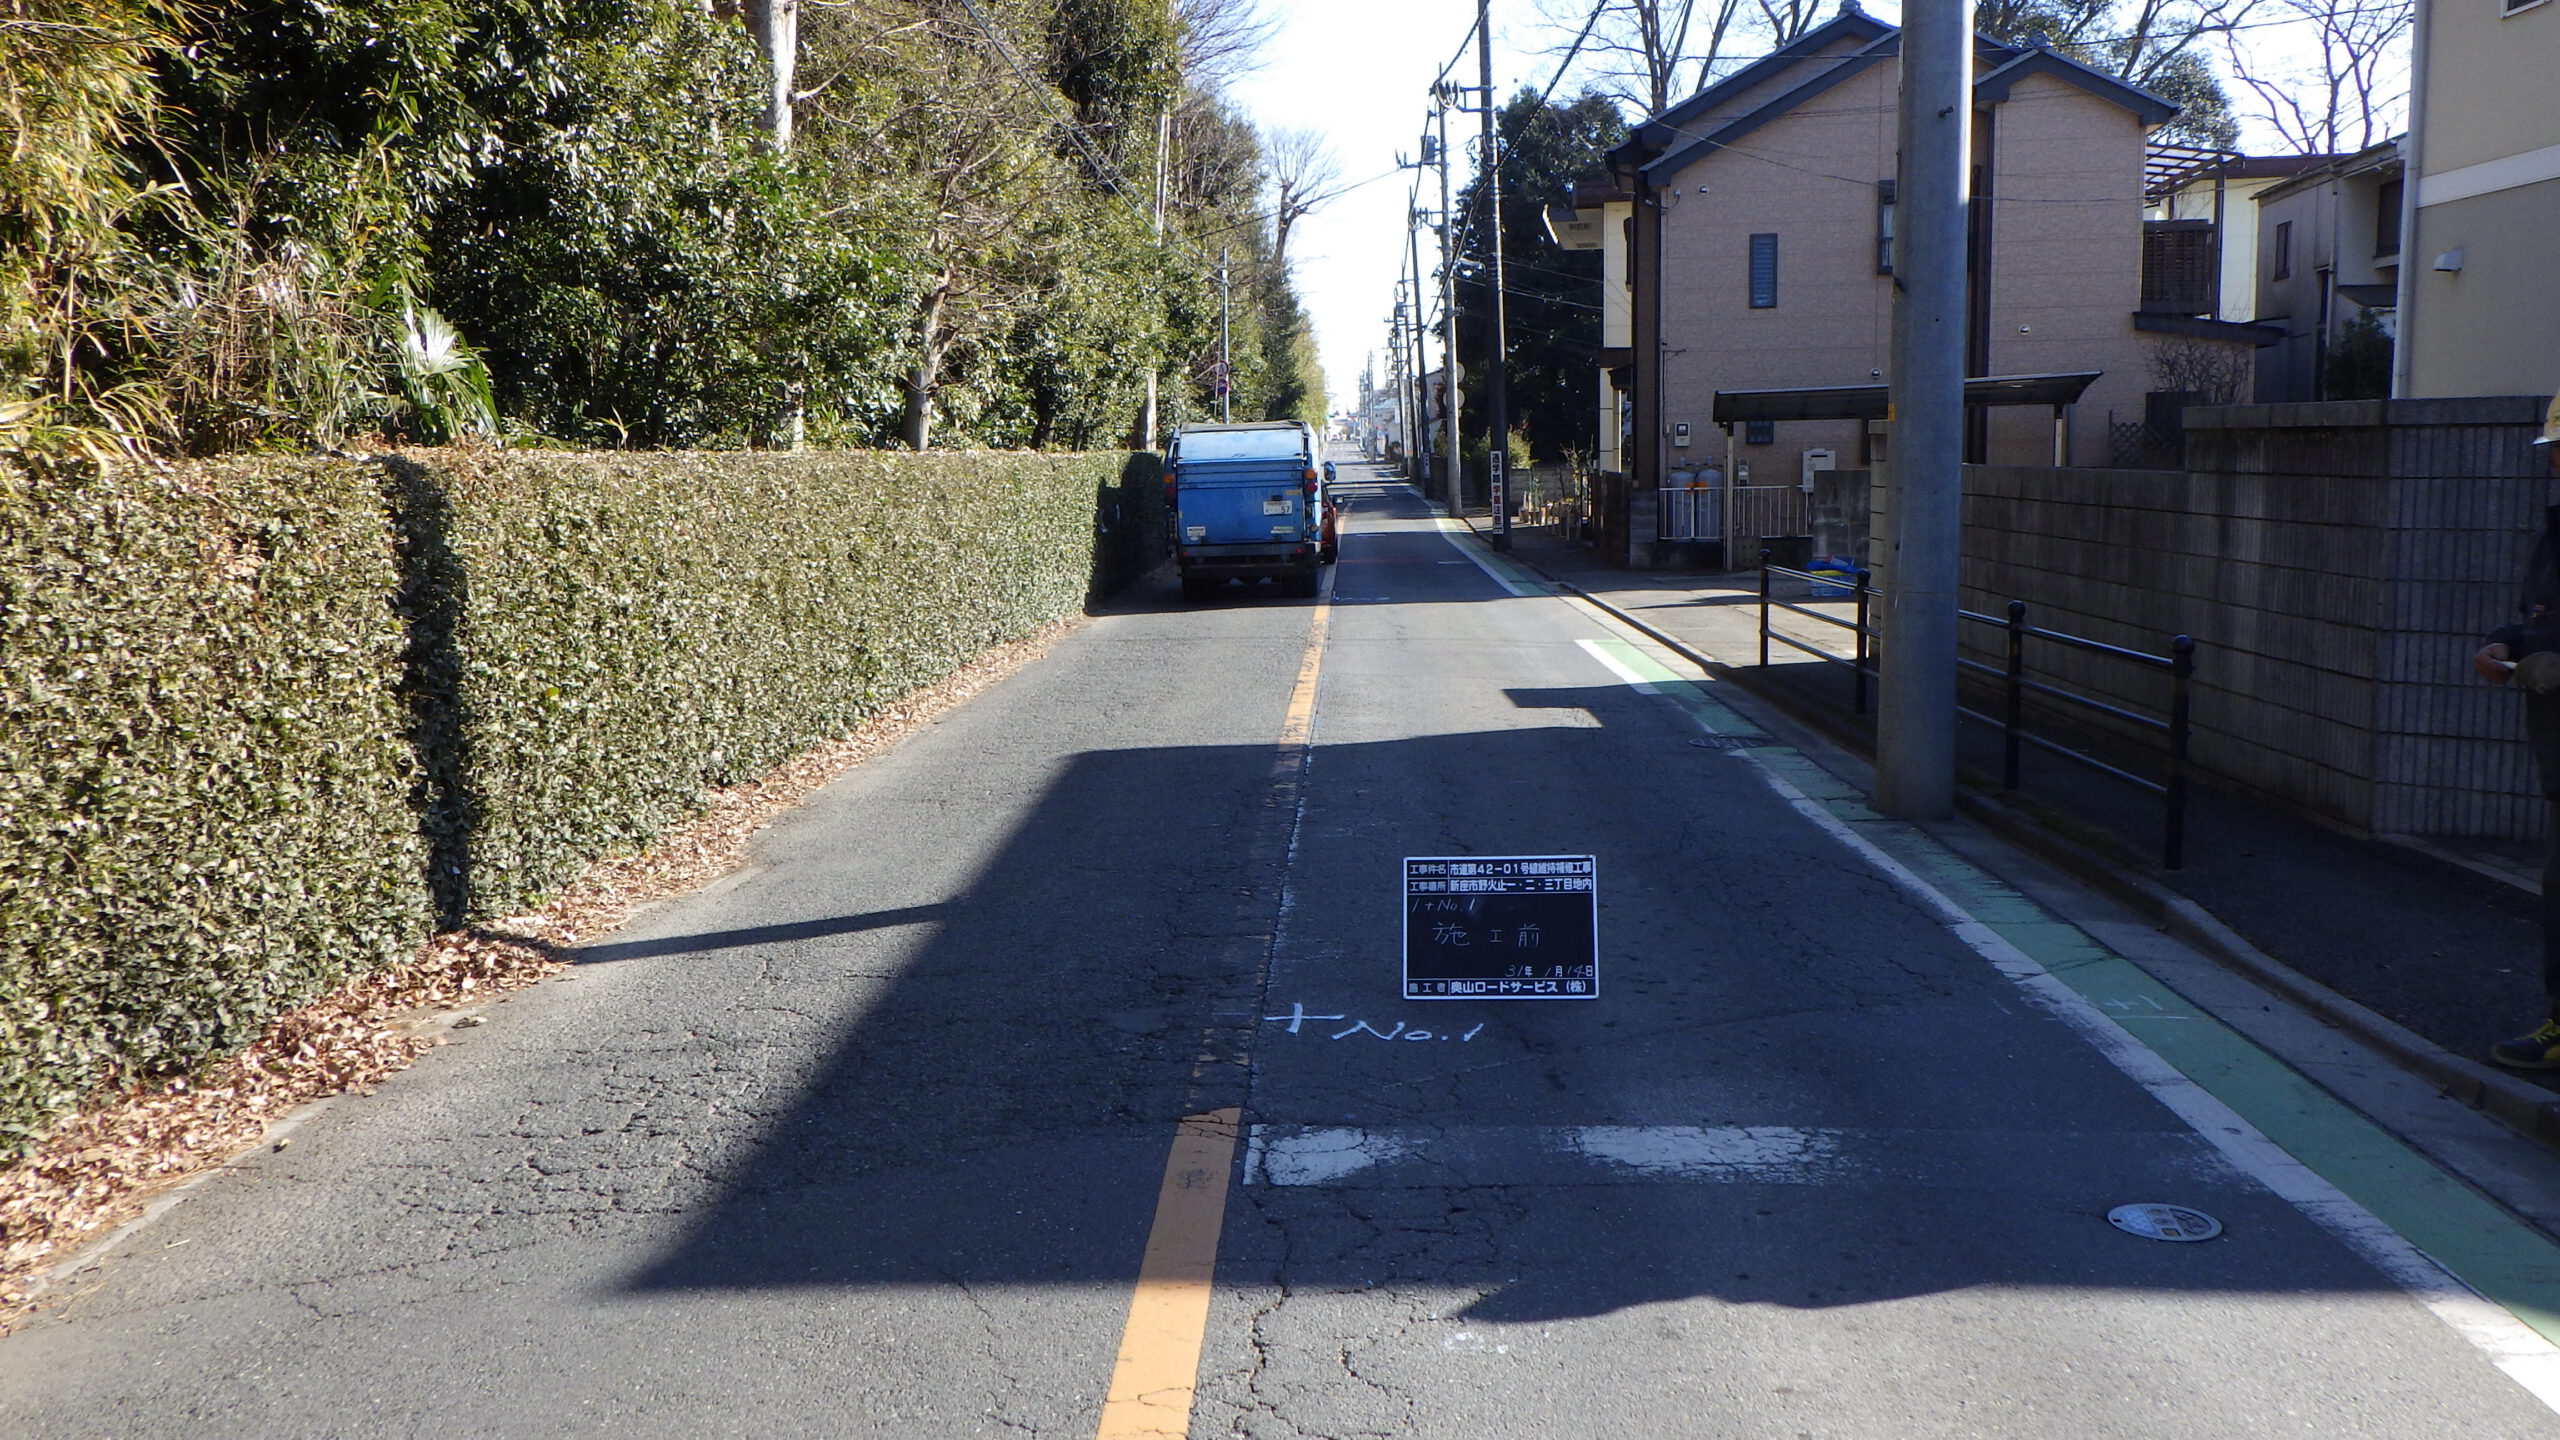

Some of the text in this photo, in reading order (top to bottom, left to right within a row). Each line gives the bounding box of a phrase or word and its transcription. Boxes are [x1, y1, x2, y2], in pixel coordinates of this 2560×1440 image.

[1409, 864, 1446, 875] 工事件名
[1409, 881, 1446, 892] 工事場所
